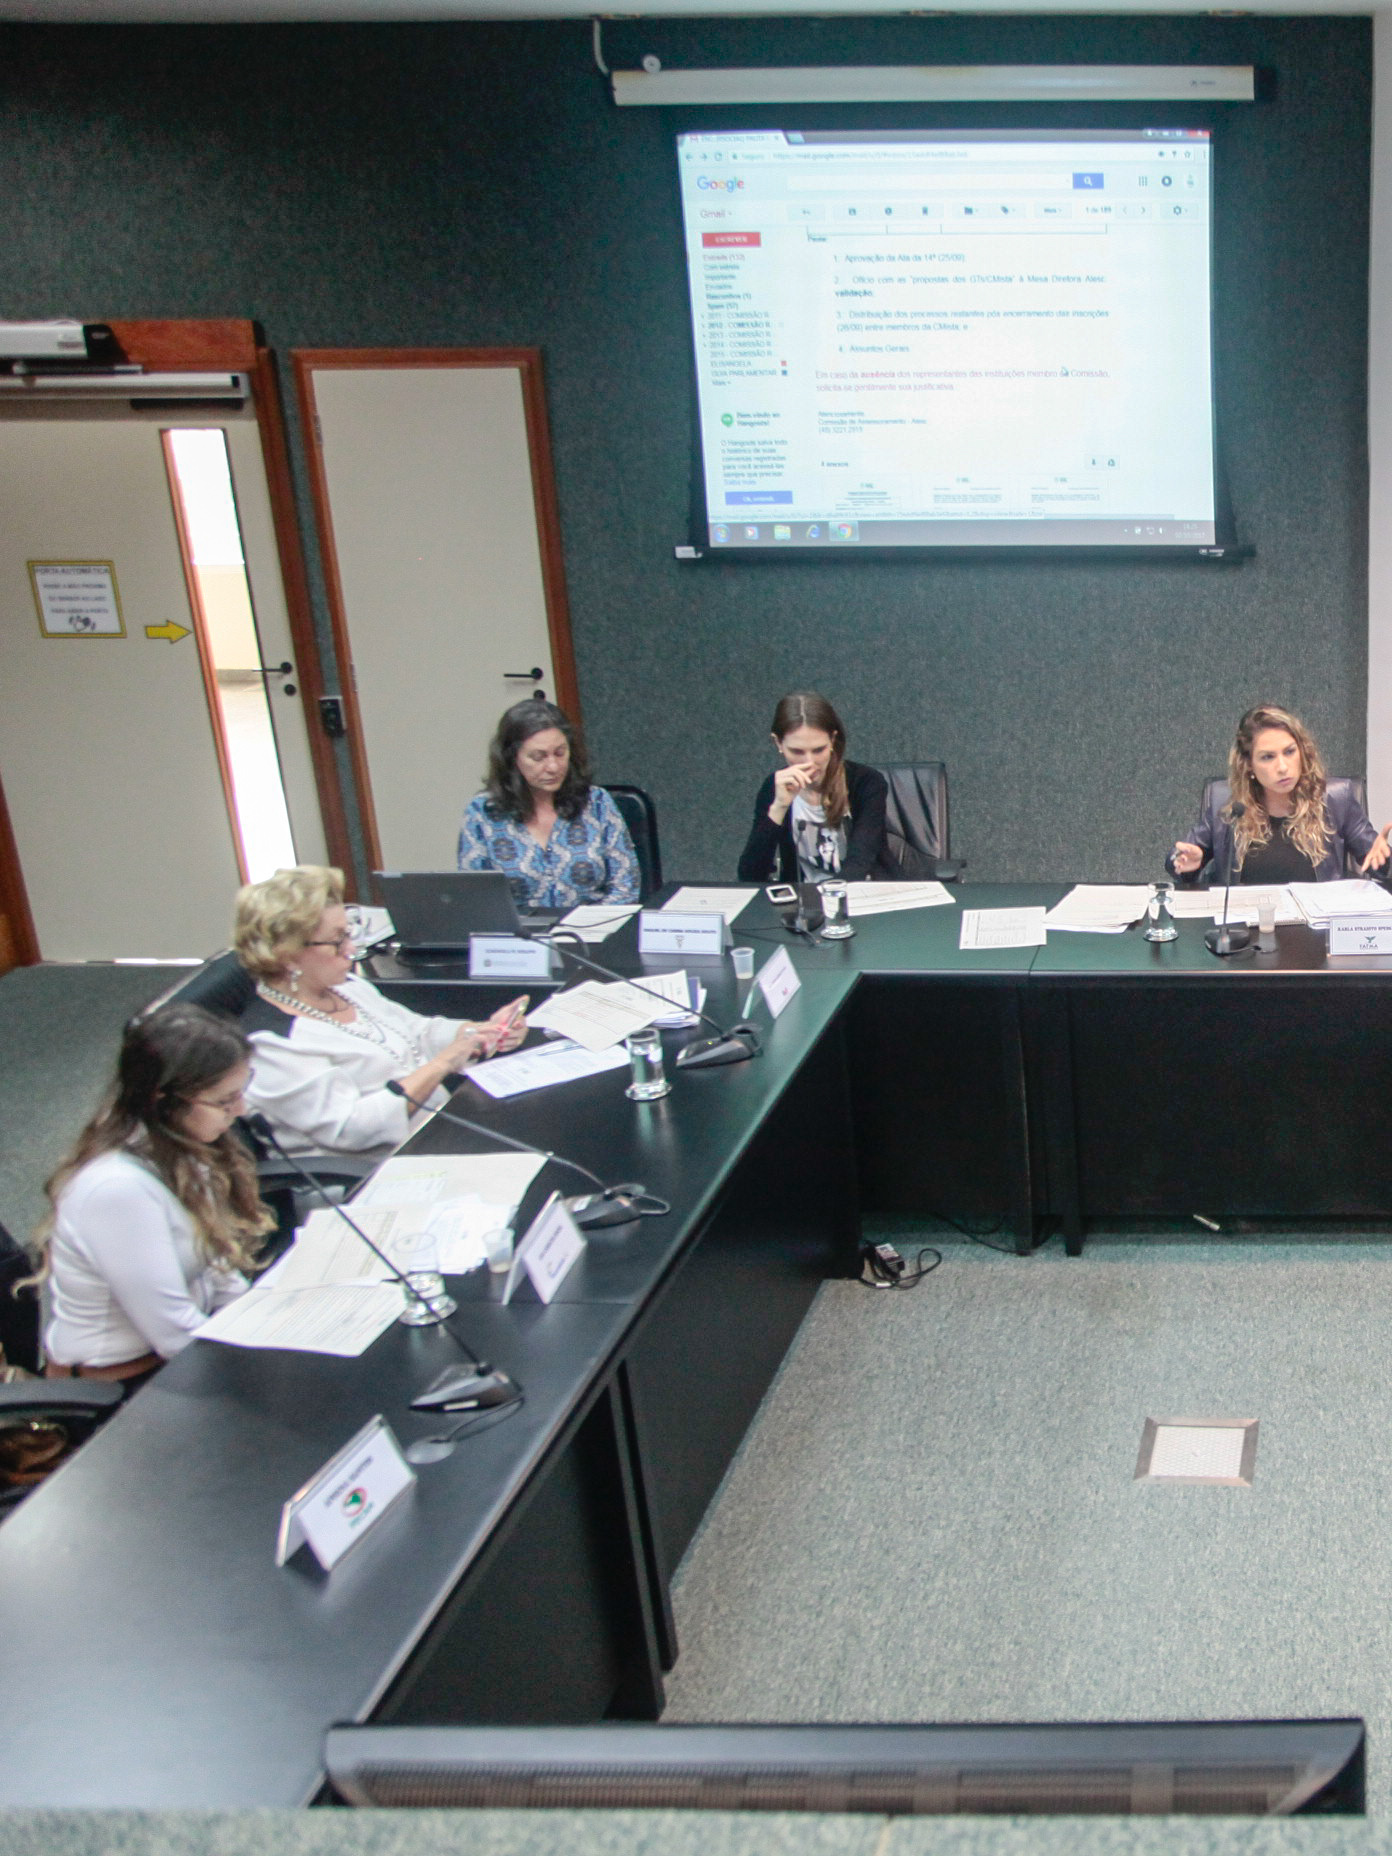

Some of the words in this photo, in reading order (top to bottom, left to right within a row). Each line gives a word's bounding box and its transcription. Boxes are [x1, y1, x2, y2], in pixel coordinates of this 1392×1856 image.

[697, 175, 744, 193] Google
[700, 209, 727, 219] Gmail
[845, 253, 885, 264] Aprovação
[886, 254, 896, 262] da
[898, 254, 911, 262] Ata
[912, 254, 922, 262] da
[878, 276, 895, 284] com
[952, 275, 967, 283] dos
[1027, 275, 1049, 283] Mesa
[1052, 275, 1082, 283] Diretora
[849, 310, 892, 320] Distribuição
[894, 310, 908, 319] dos
[910, 311, 948, 321] processos
[951, 310, 985, 319] restantes
[1003, 310, 1054, 318] encerramento
[1056, 310, 1070, 318] das
[1072, 309, 1109, 319] inscrições
[886, 323, 921, 331] membros
[849, 344, 884, 353] Assuntos
[885, 344, 910, 353] Gerais
[816, 371, 828, 379] Em
[849, 371, 859, 379] da
[860, 370, 896, 379] ausência
[897, 370, 911, 378] dos
[913, 370, 968, 380] representantes
[969, 370, 982, 378] das
[985, 369, 1025, 379] instituições
[1027, 369, 1058, 378] membro
[854, 383, 897, 393] gentilmente
